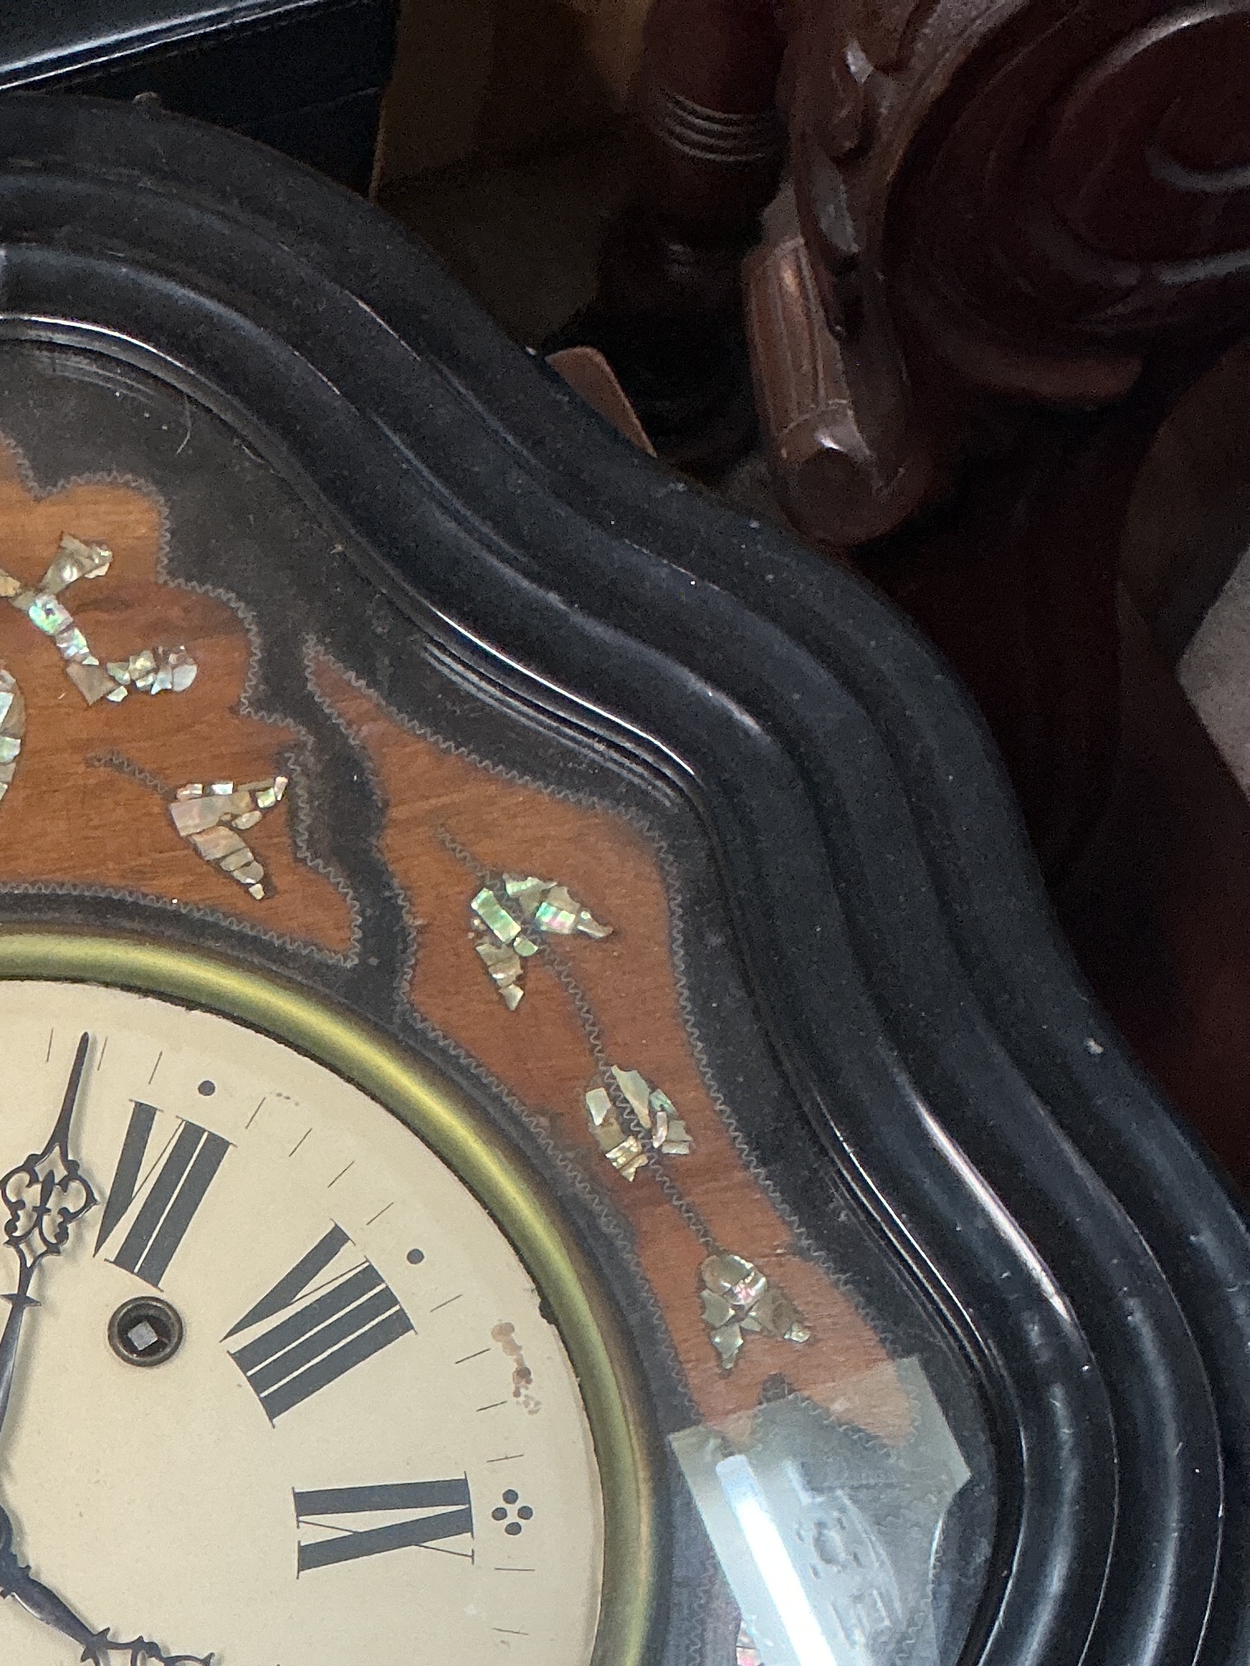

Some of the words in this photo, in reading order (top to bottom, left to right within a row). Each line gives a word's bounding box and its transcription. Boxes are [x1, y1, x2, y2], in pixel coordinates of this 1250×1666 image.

[93, 1099, 238, 1292] VII
[219, 1219, 418, 1429] VIII
[293, 1471, 475, 1580] IX
